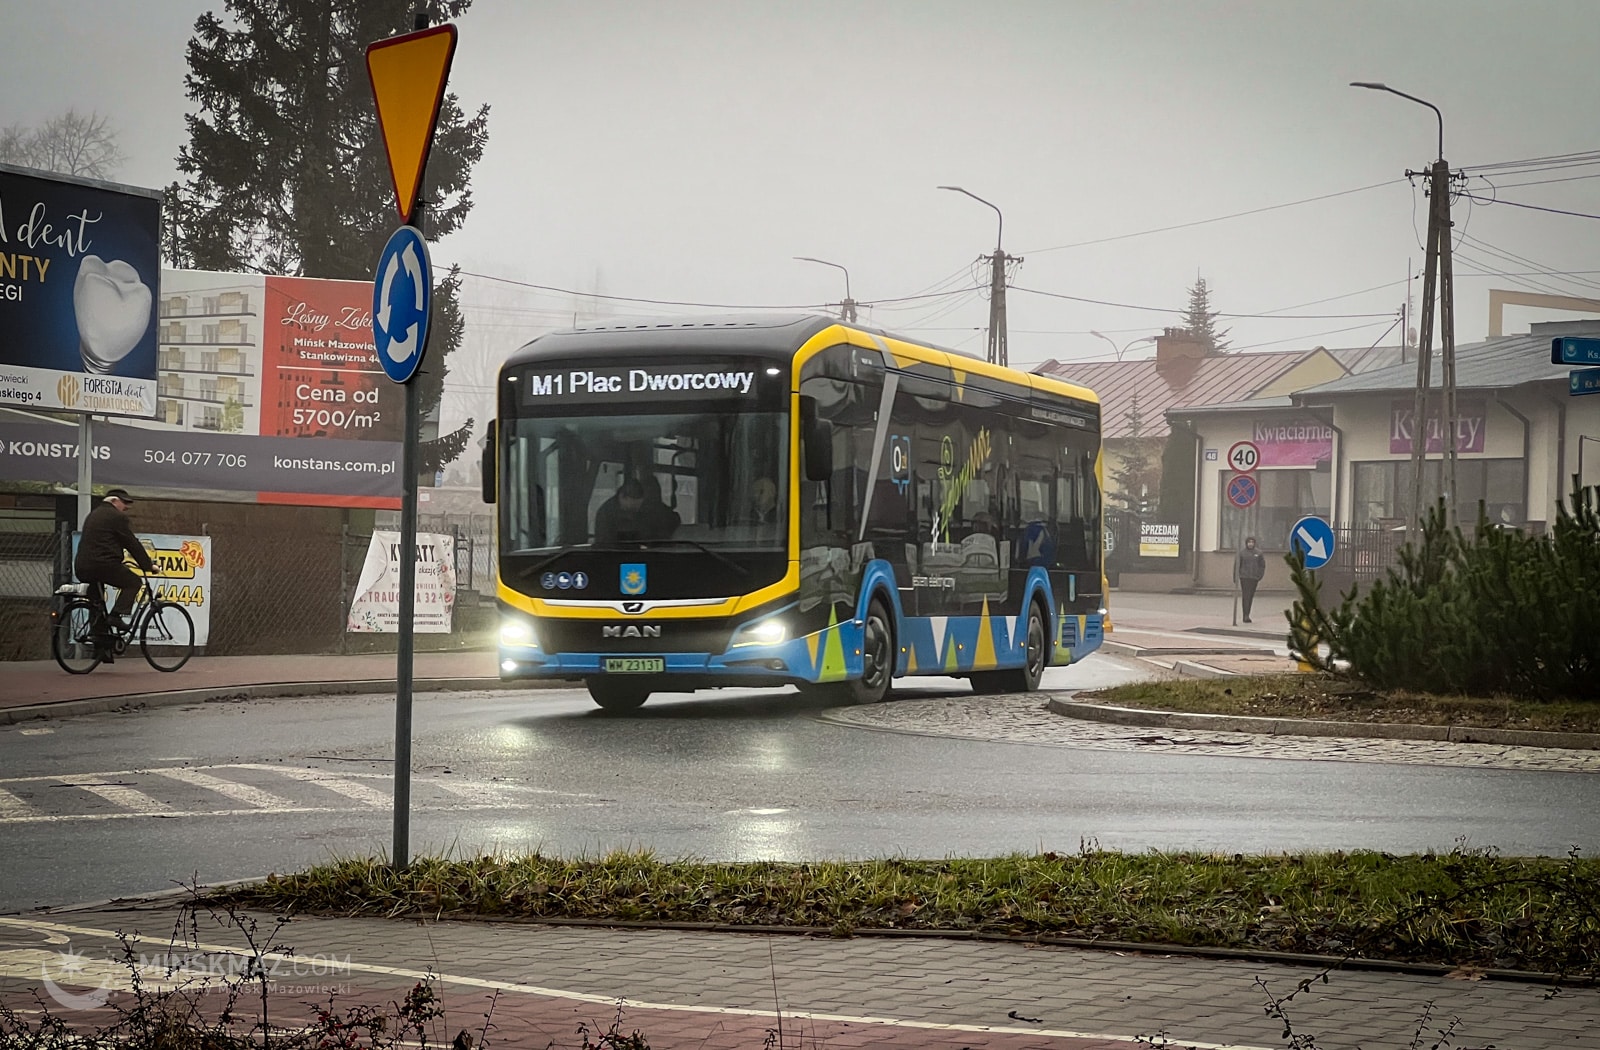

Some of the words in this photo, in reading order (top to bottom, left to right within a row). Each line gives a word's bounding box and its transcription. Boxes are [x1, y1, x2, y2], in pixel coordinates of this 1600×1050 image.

[17, 202, 103, 257] dent
[281, 302, 330, 331] Leśny
[294, 337, 325, 347] Mińsk
[300, 350, 366, 363] Stankowizna
[532, 375, 563, 395] M1
[570, 371, 622, 393] Plac
[629, 370, 754, 394] Dworcowy
[0, 387, 34, 402] skiego
[35, 391, 42, 401] 4
[295, 384, 346, 402] Cena
[353, 387, 379, 404] od
[83, 395, 144, 412] STOMATOLOGIA
[1255, 421, 1332, 442] Kwiaciarnia
[144, 450, 176, 464] 504
[181, 452, 212, 466] 077
[216, 453, 247, 468] 706
[274, 456, 395, 475] konstans.com.pl
[1233, 450, 1255, 465] 40
[1141, 524, 1179, 536] SPRZEDAM
[180, 541, 205, 568] 24h
[158, 556, 188, 572] TAXI
[603, 625, 661, 637] MAN
[626, 660, 660, 671] 2313T
